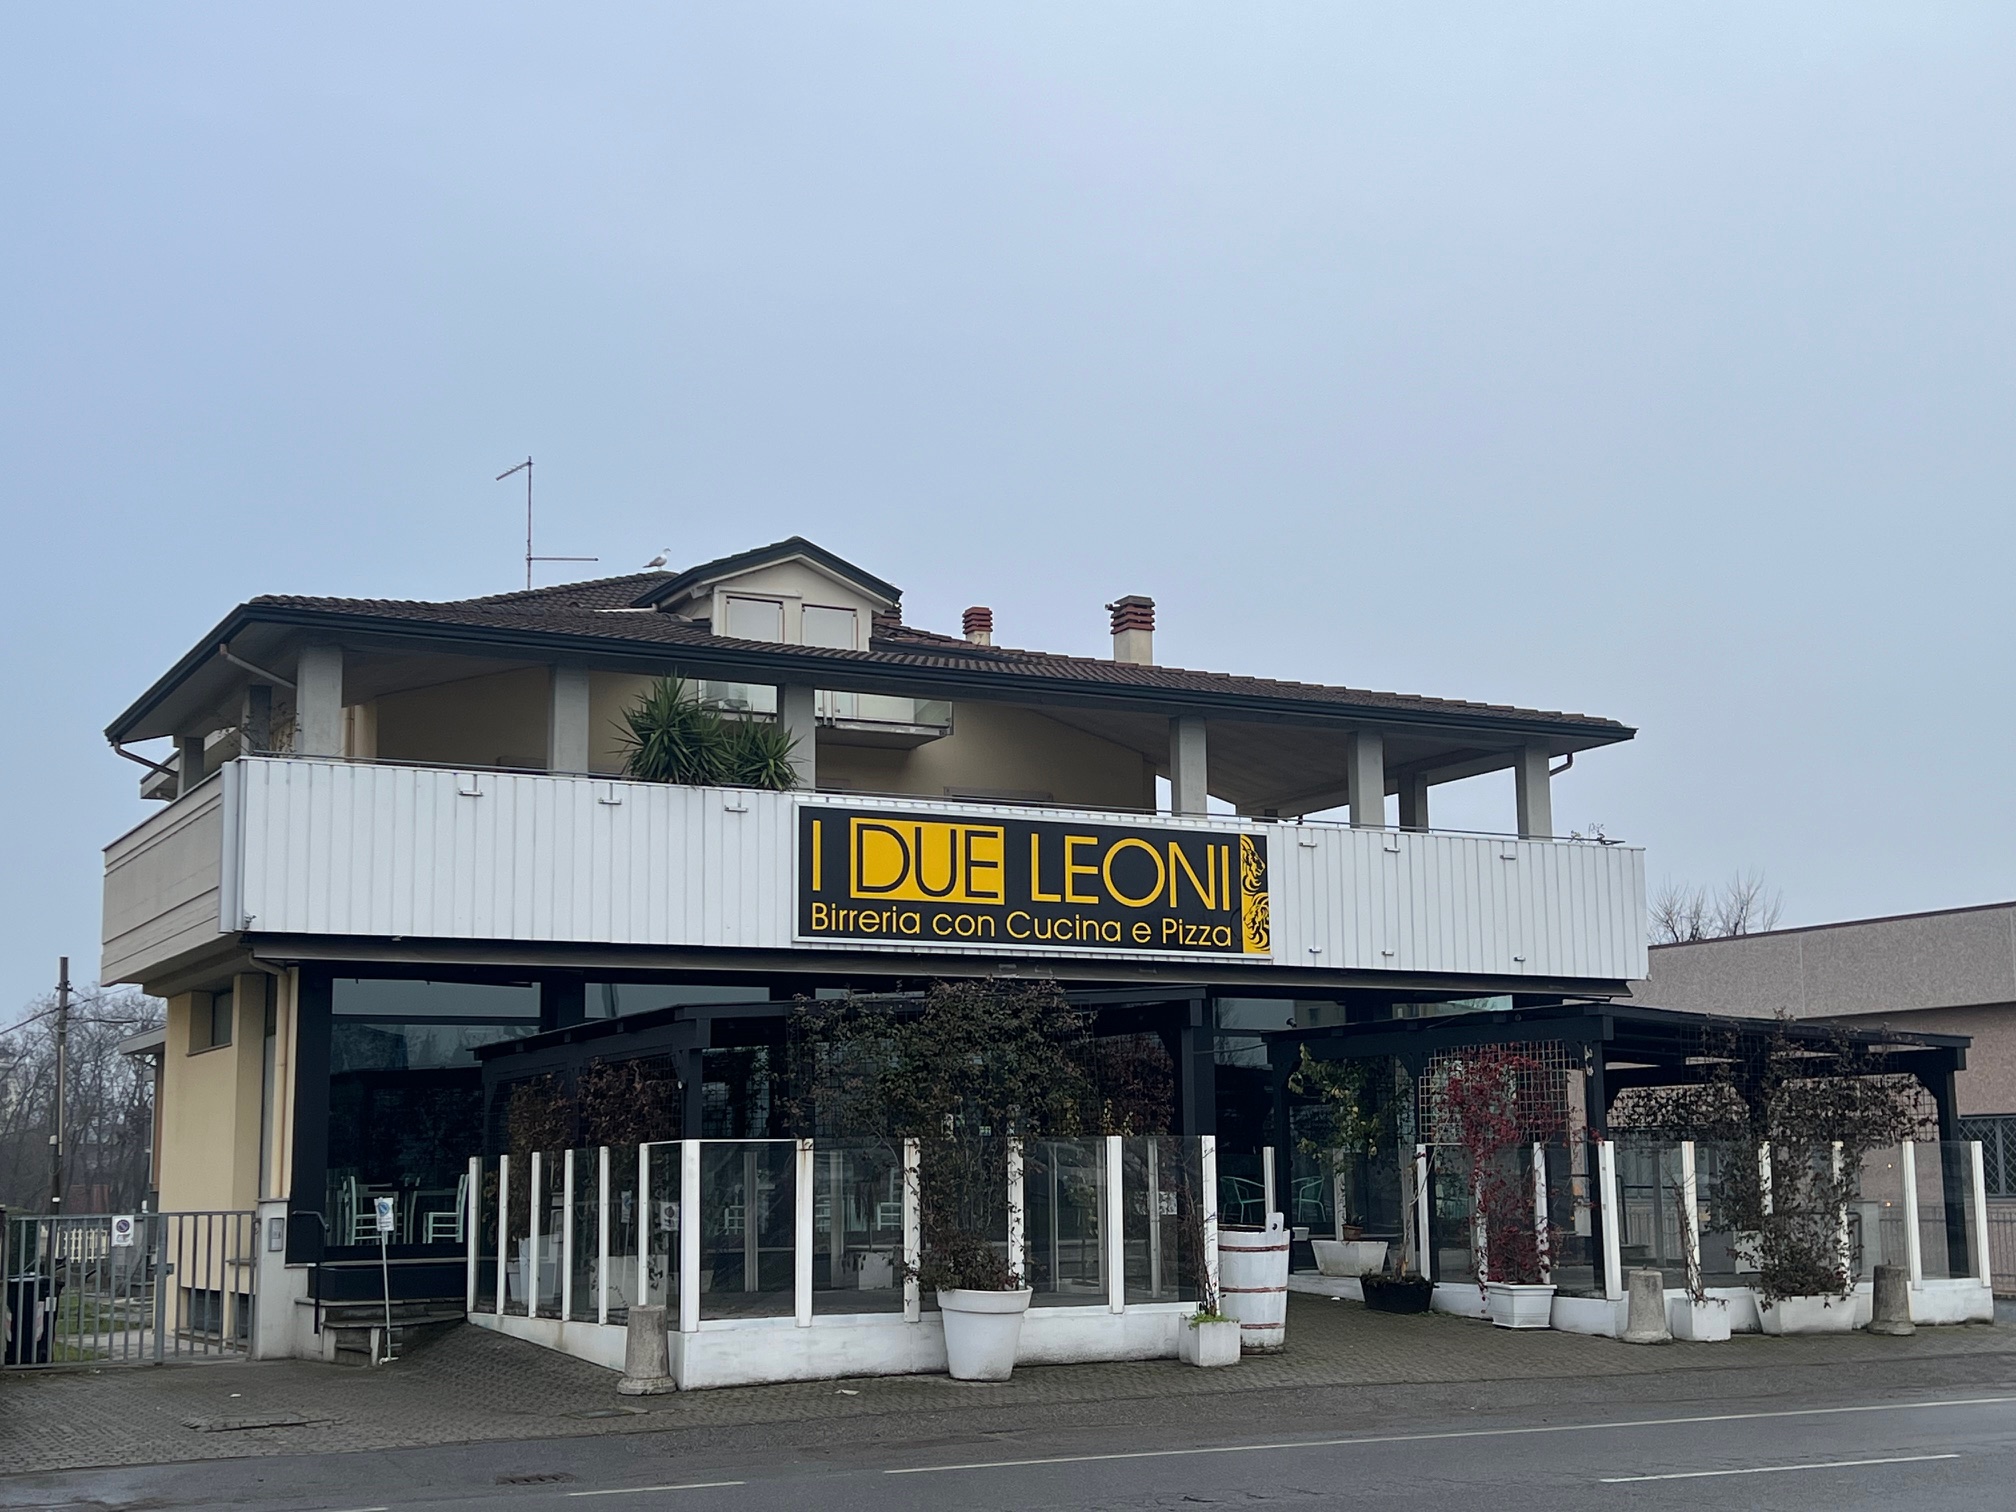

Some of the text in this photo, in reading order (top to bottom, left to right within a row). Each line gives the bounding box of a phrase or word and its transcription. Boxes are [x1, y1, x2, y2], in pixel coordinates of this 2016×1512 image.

[812, 819, 1231, 911] I DUE LEONI
[811, 902, 1232, 948] Birreria con Cucina e Pizza
